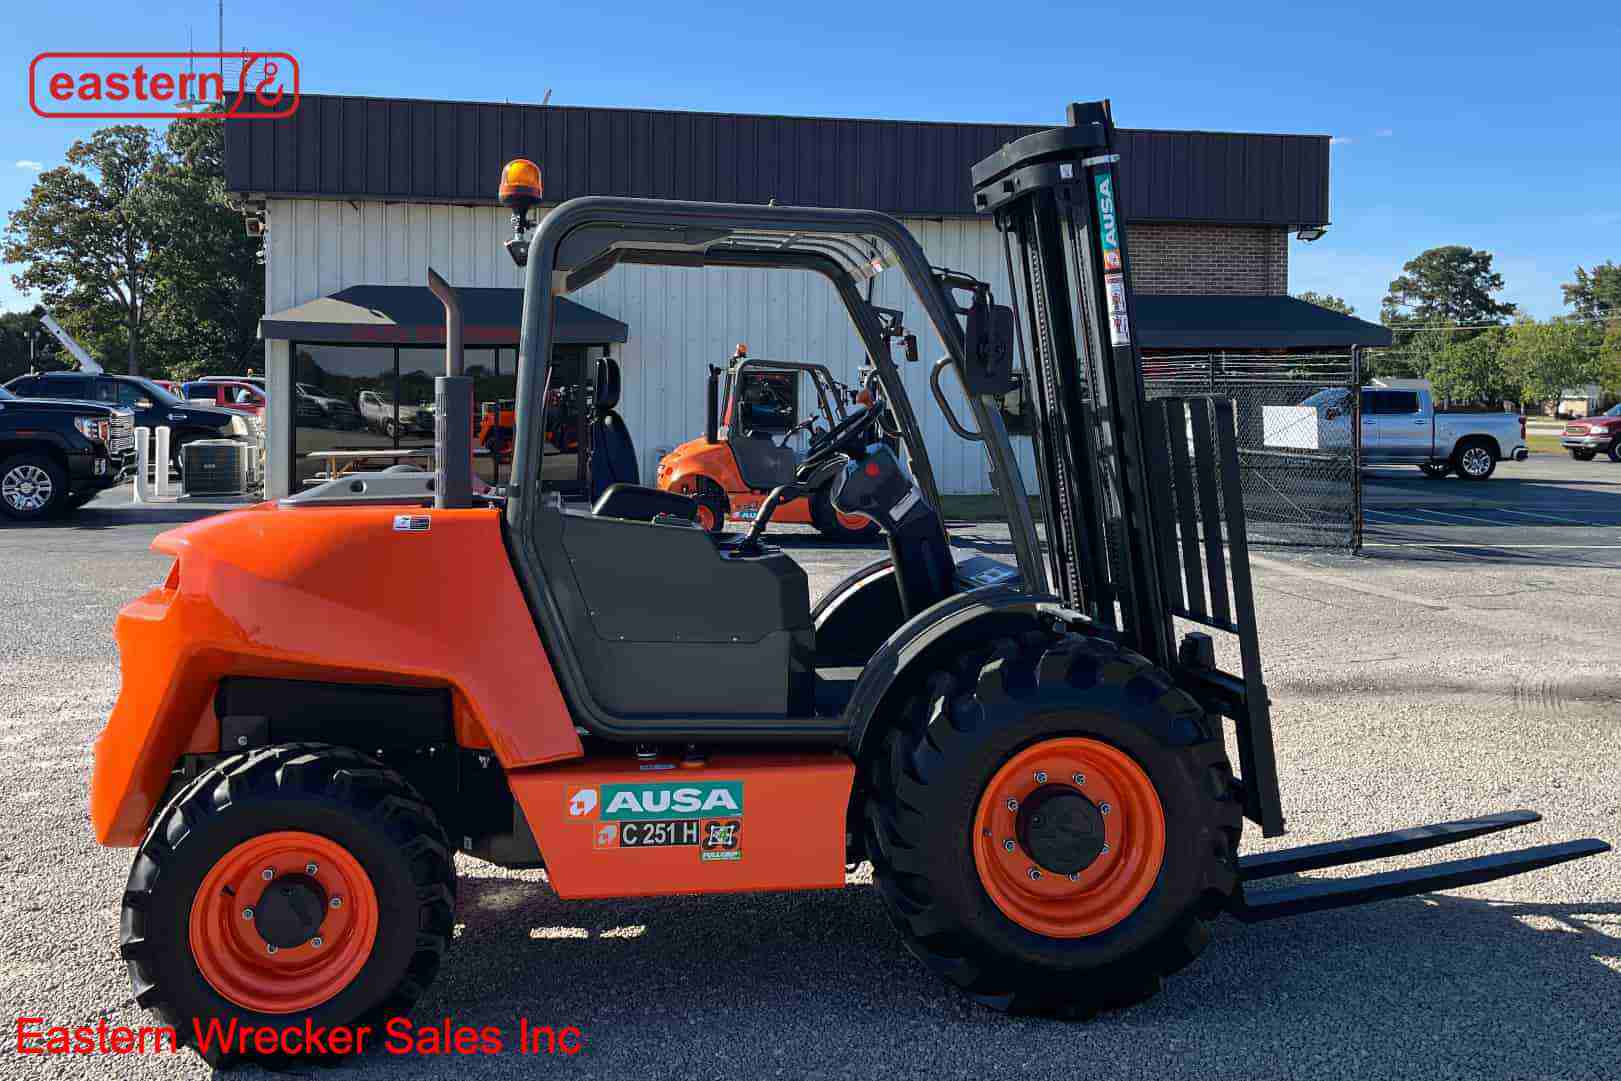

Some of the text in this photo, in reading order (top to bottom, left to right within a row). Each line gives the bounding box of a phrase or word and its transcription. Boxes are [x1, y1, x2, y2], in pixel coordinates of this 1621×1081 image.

[1100, 178, 1118, 248] AUSA
[605, 788, 739, 814] AUSA
[622, 822, 698, 845] C 251 H
